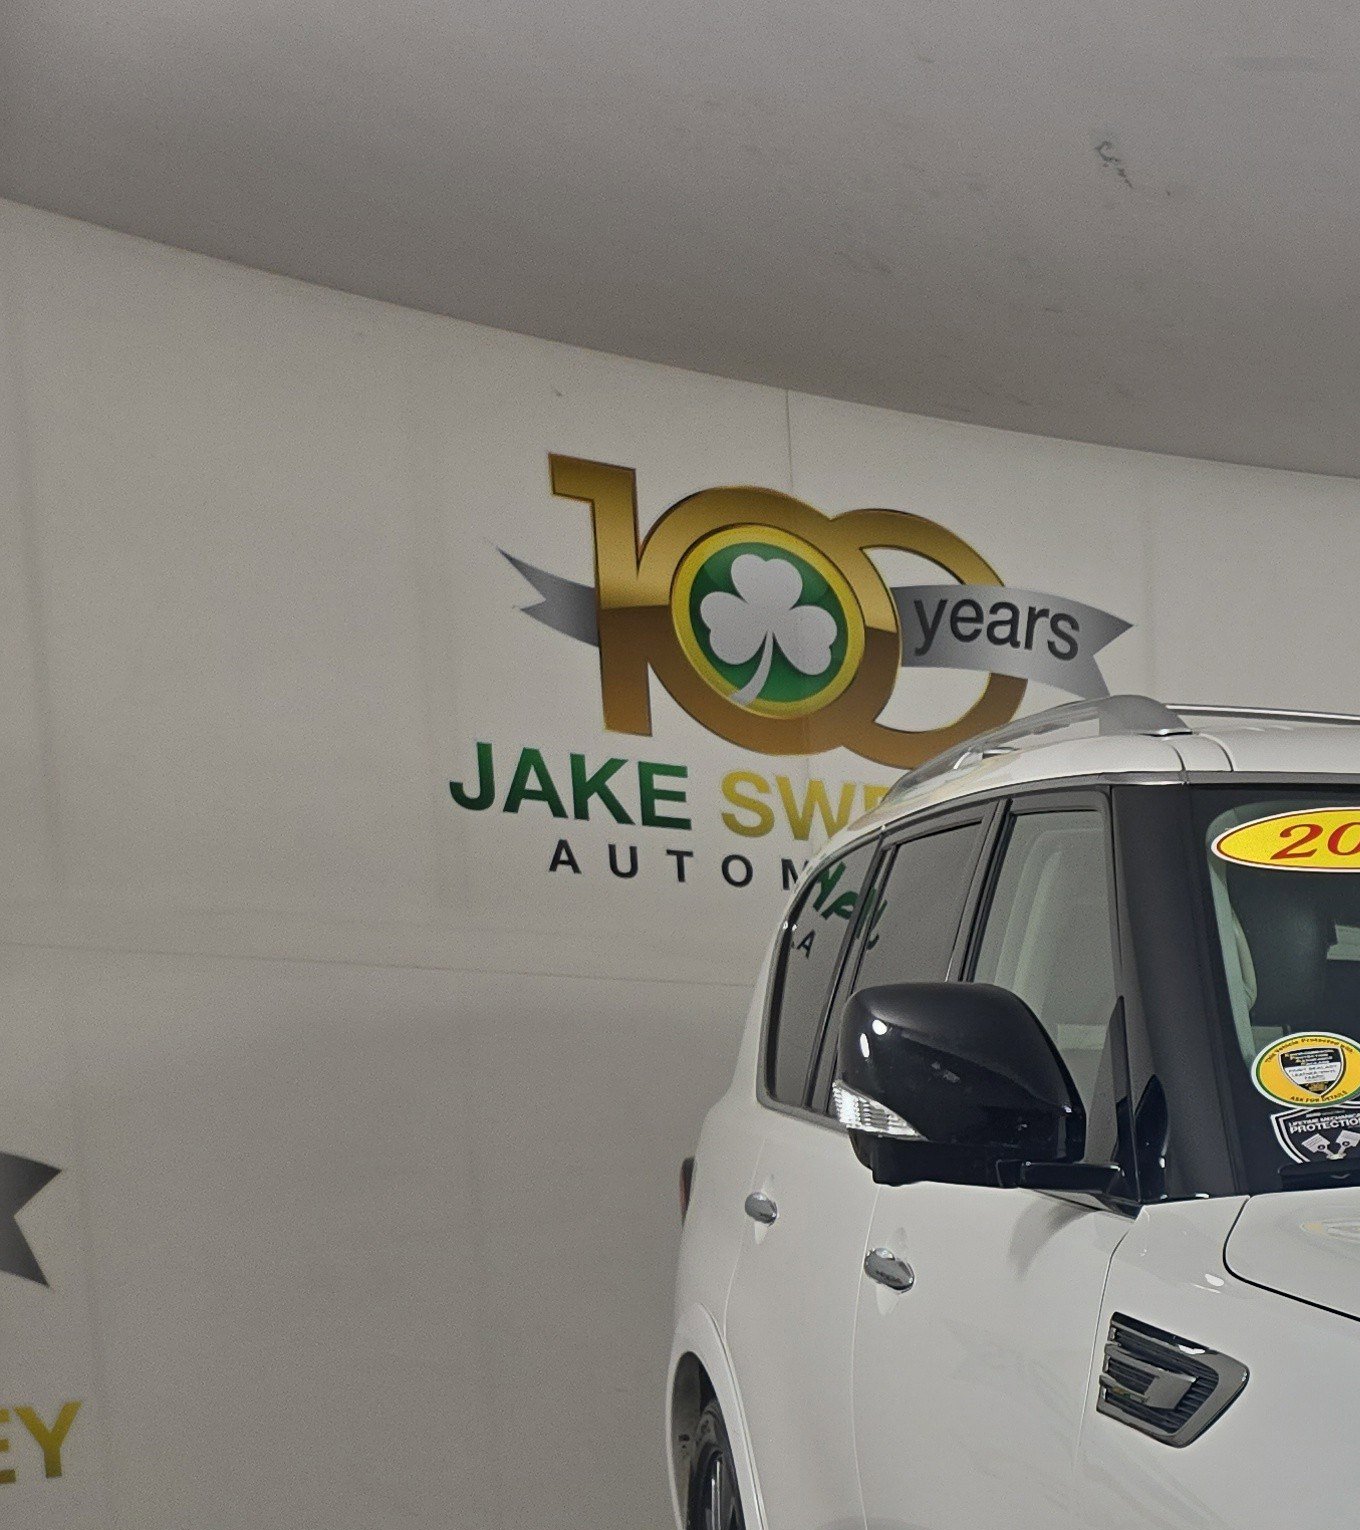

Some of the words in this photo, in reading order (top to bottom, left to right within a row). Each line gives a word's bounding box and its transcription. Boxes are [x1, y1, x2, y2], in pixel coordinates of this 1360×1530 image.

[547, 452, 1028, 771] 100
[911, 596, 1081, 662] years
[448, 741, 693, 832] JAKE
